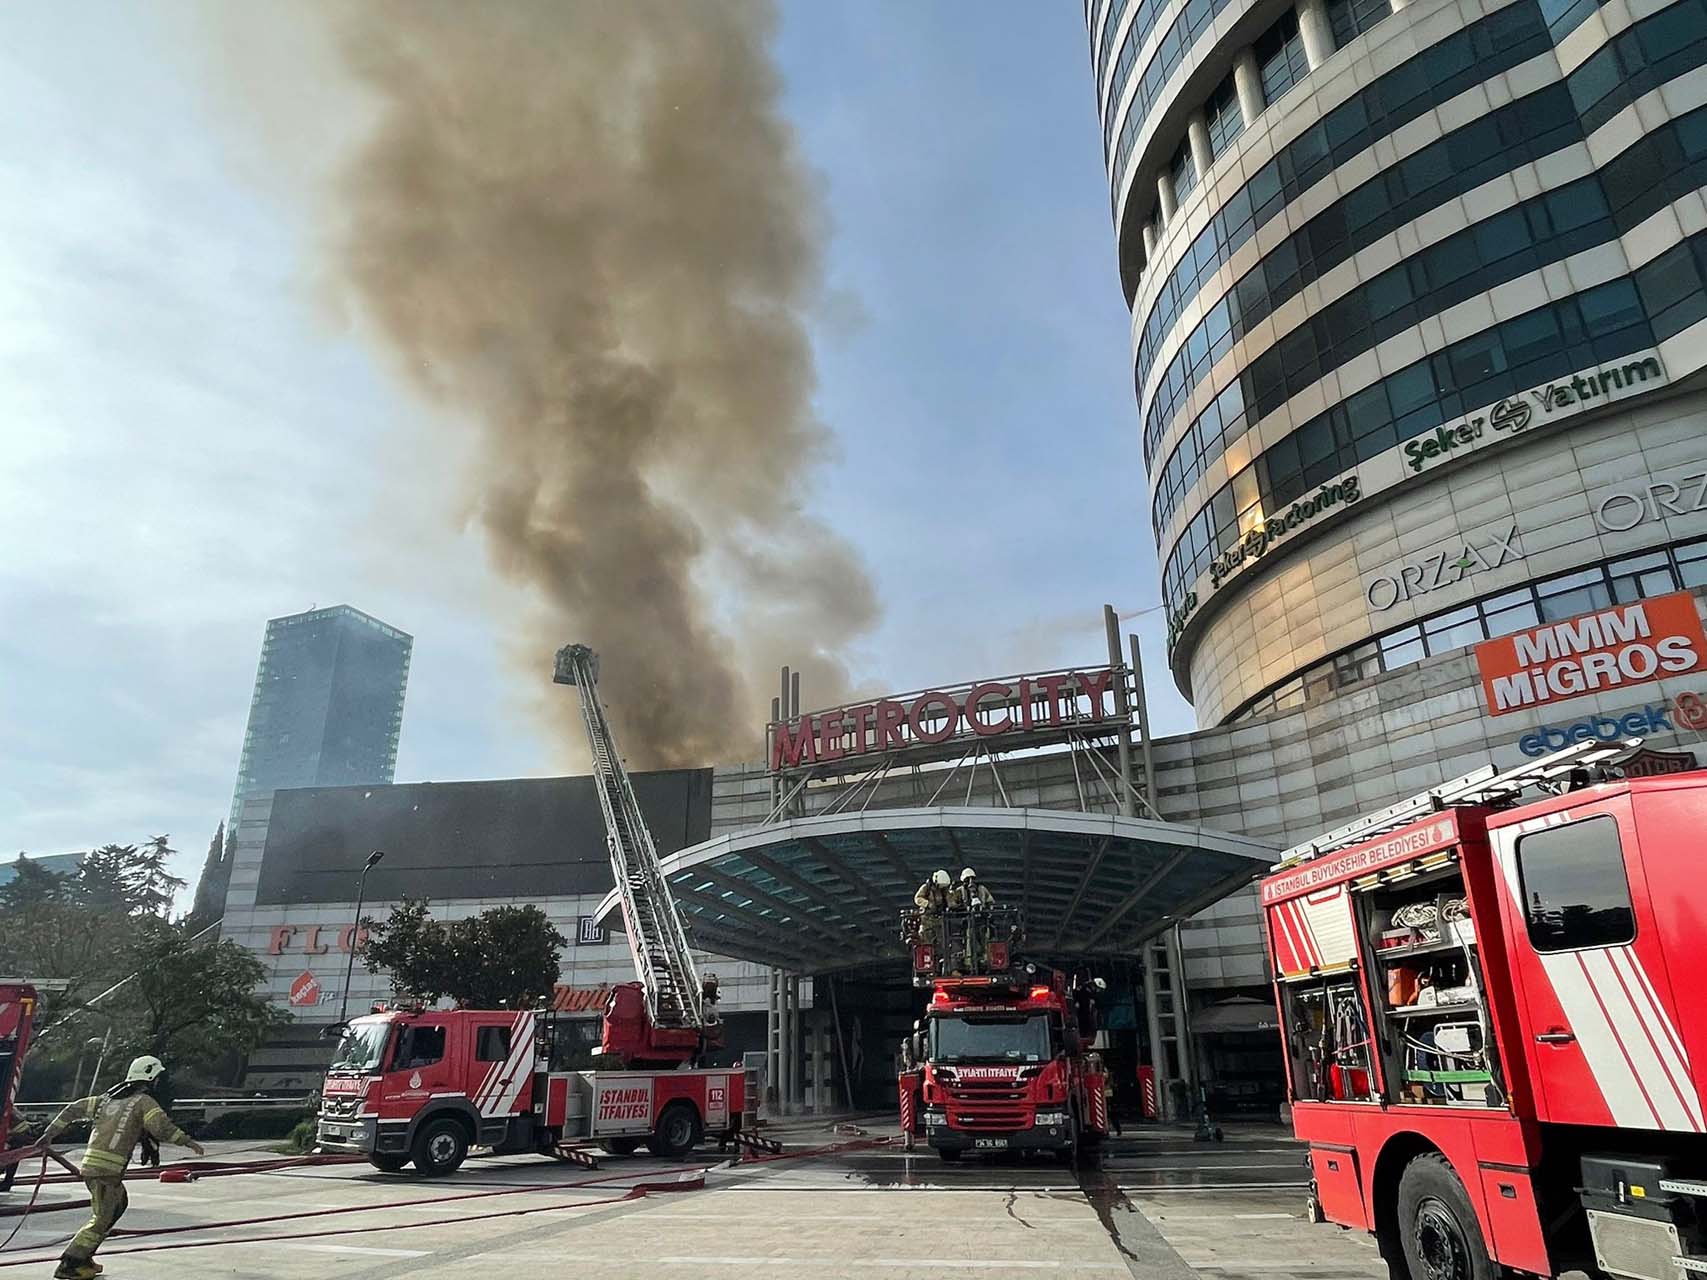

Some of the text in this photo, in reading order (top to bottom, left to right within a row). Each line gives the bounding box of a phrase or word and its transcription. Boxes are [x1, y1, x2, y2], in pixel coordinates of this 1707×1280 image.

[1404, 357, 1661, 472] Şeker Yatırım
[1265, 476, 1361, 542] Factoring
[1368, 525, 1524, 611] ORZAX
[1513, 604, 1652, 668] MMM
[771, 671, 1114, 771] METROCITY
[1519, 704, 1674, 757] ebebek
[711, 1089, 724, 1101] 112
